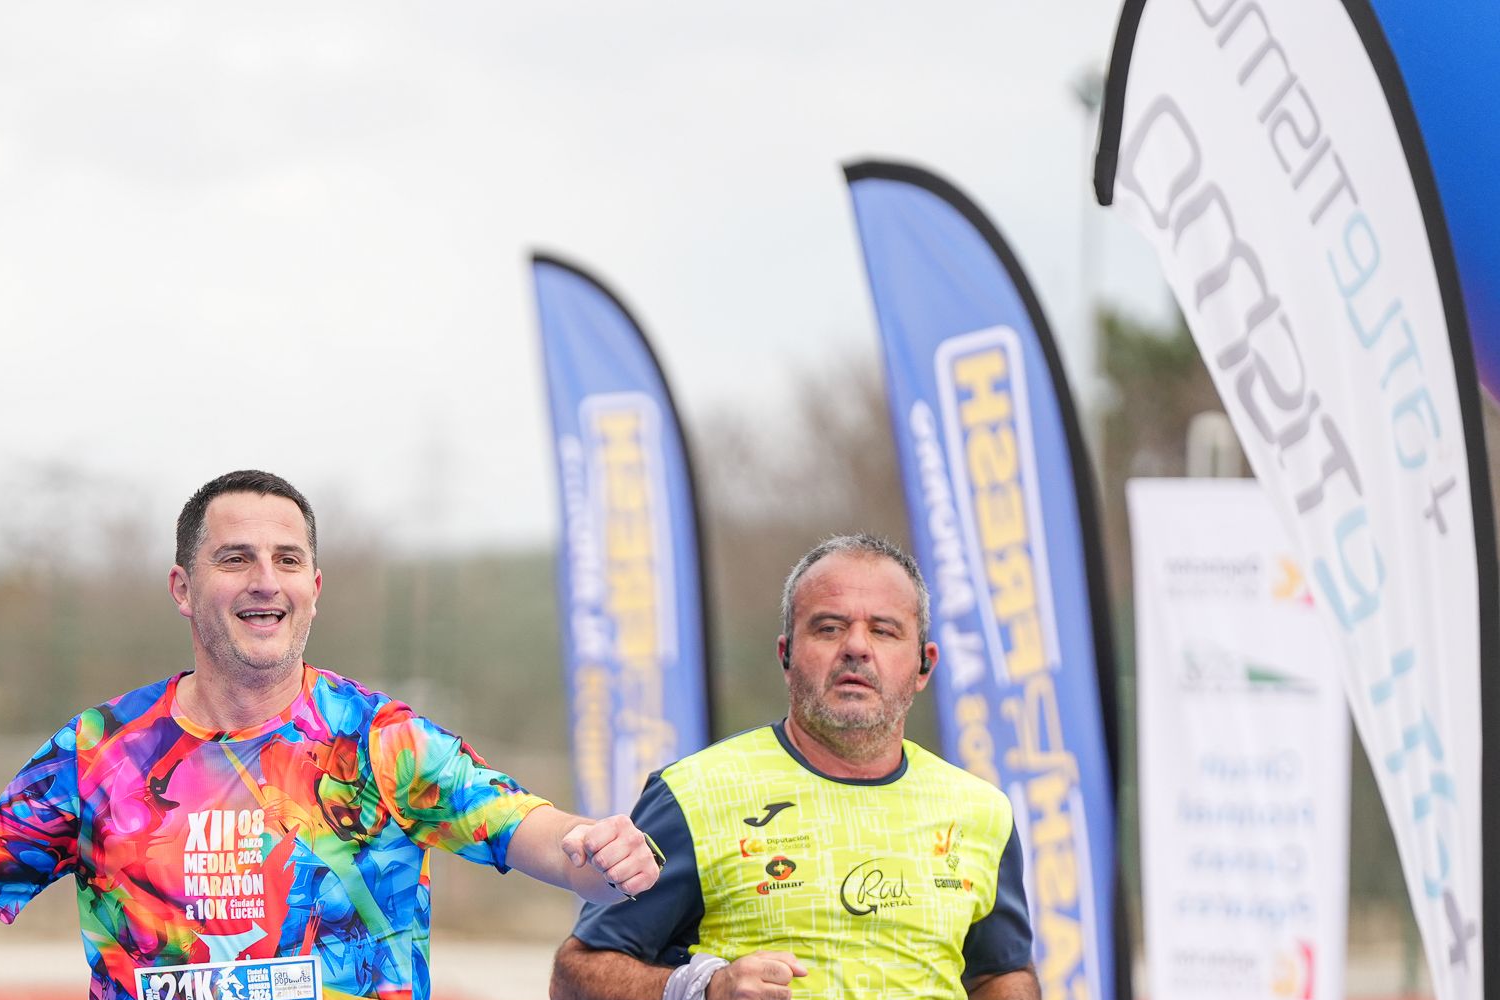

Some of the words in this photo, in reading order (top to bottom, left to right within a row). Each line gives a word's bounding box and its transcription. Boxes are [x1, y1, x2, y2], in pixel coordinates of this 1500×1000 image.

[184, 810, 236, 852] XII
[237, 809, 264, 836] 08
[238, 837, 263, 849] MARZO
[184, 852, 236, 874] MEDIA
[238, 851, 263, 865] 2026
[184, 867, 264, 897] MARATÓN
[185, 904, 195, 921] &
[196, 899, 228, 921] 10K
[230, 899, 254, 908] Ciudad
[256, 899, 265, 907] de
[880, 899, 913, 909] METAL
[230, 908, 265, 919] LUCENA
